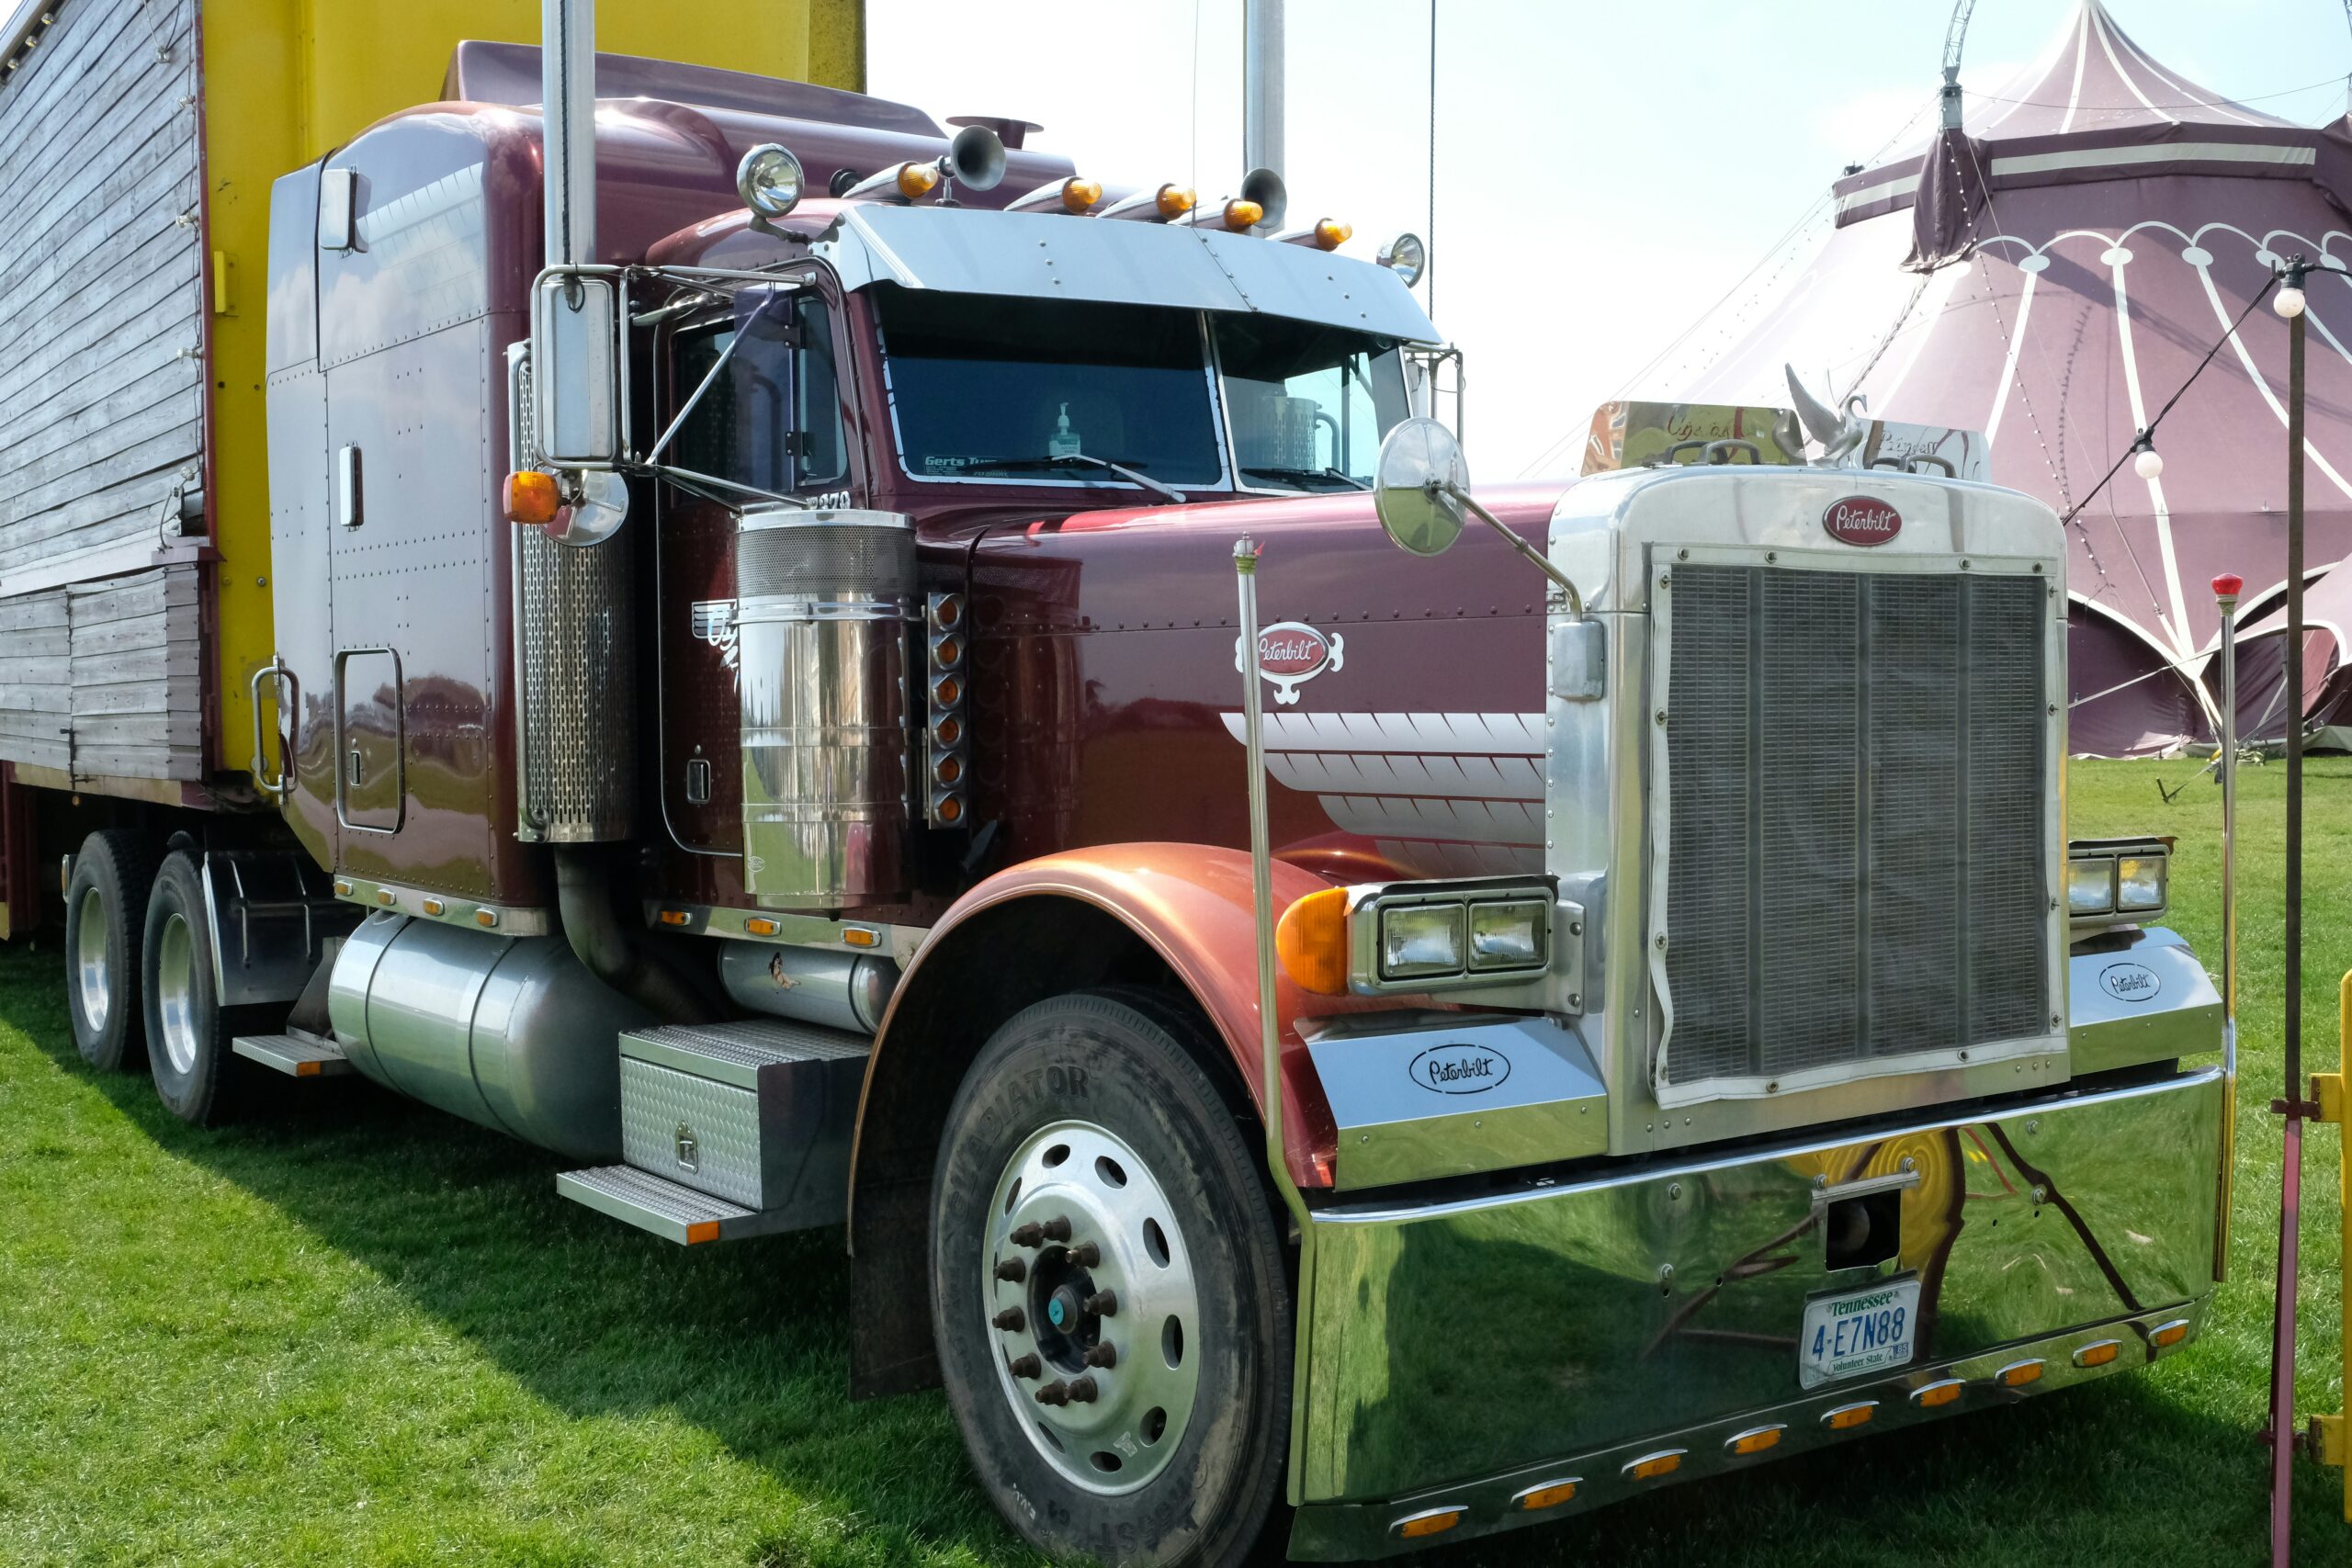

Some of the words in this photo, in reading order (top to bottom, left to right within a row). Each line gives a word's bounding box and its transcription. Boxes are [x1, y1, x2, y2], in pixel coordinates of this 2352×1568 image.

[925, 456, 965, 467] Gerts
[1836, 505, 1896, 531] Peterbilt
[1259, 637, 1318, 660] Peterbilt
[2110, 974, 2151, 994] Peterbilt
[1429, 1057, 1494, 1085] Peterbilt
[1830, 1291, 1894, 1317] Tennessee
[1812, 1306, 1906, 1361] 4-E7N88
[1833, 1358, 1865, 1372] Volunteer
[1866, 1352, 1883, 1365] State
